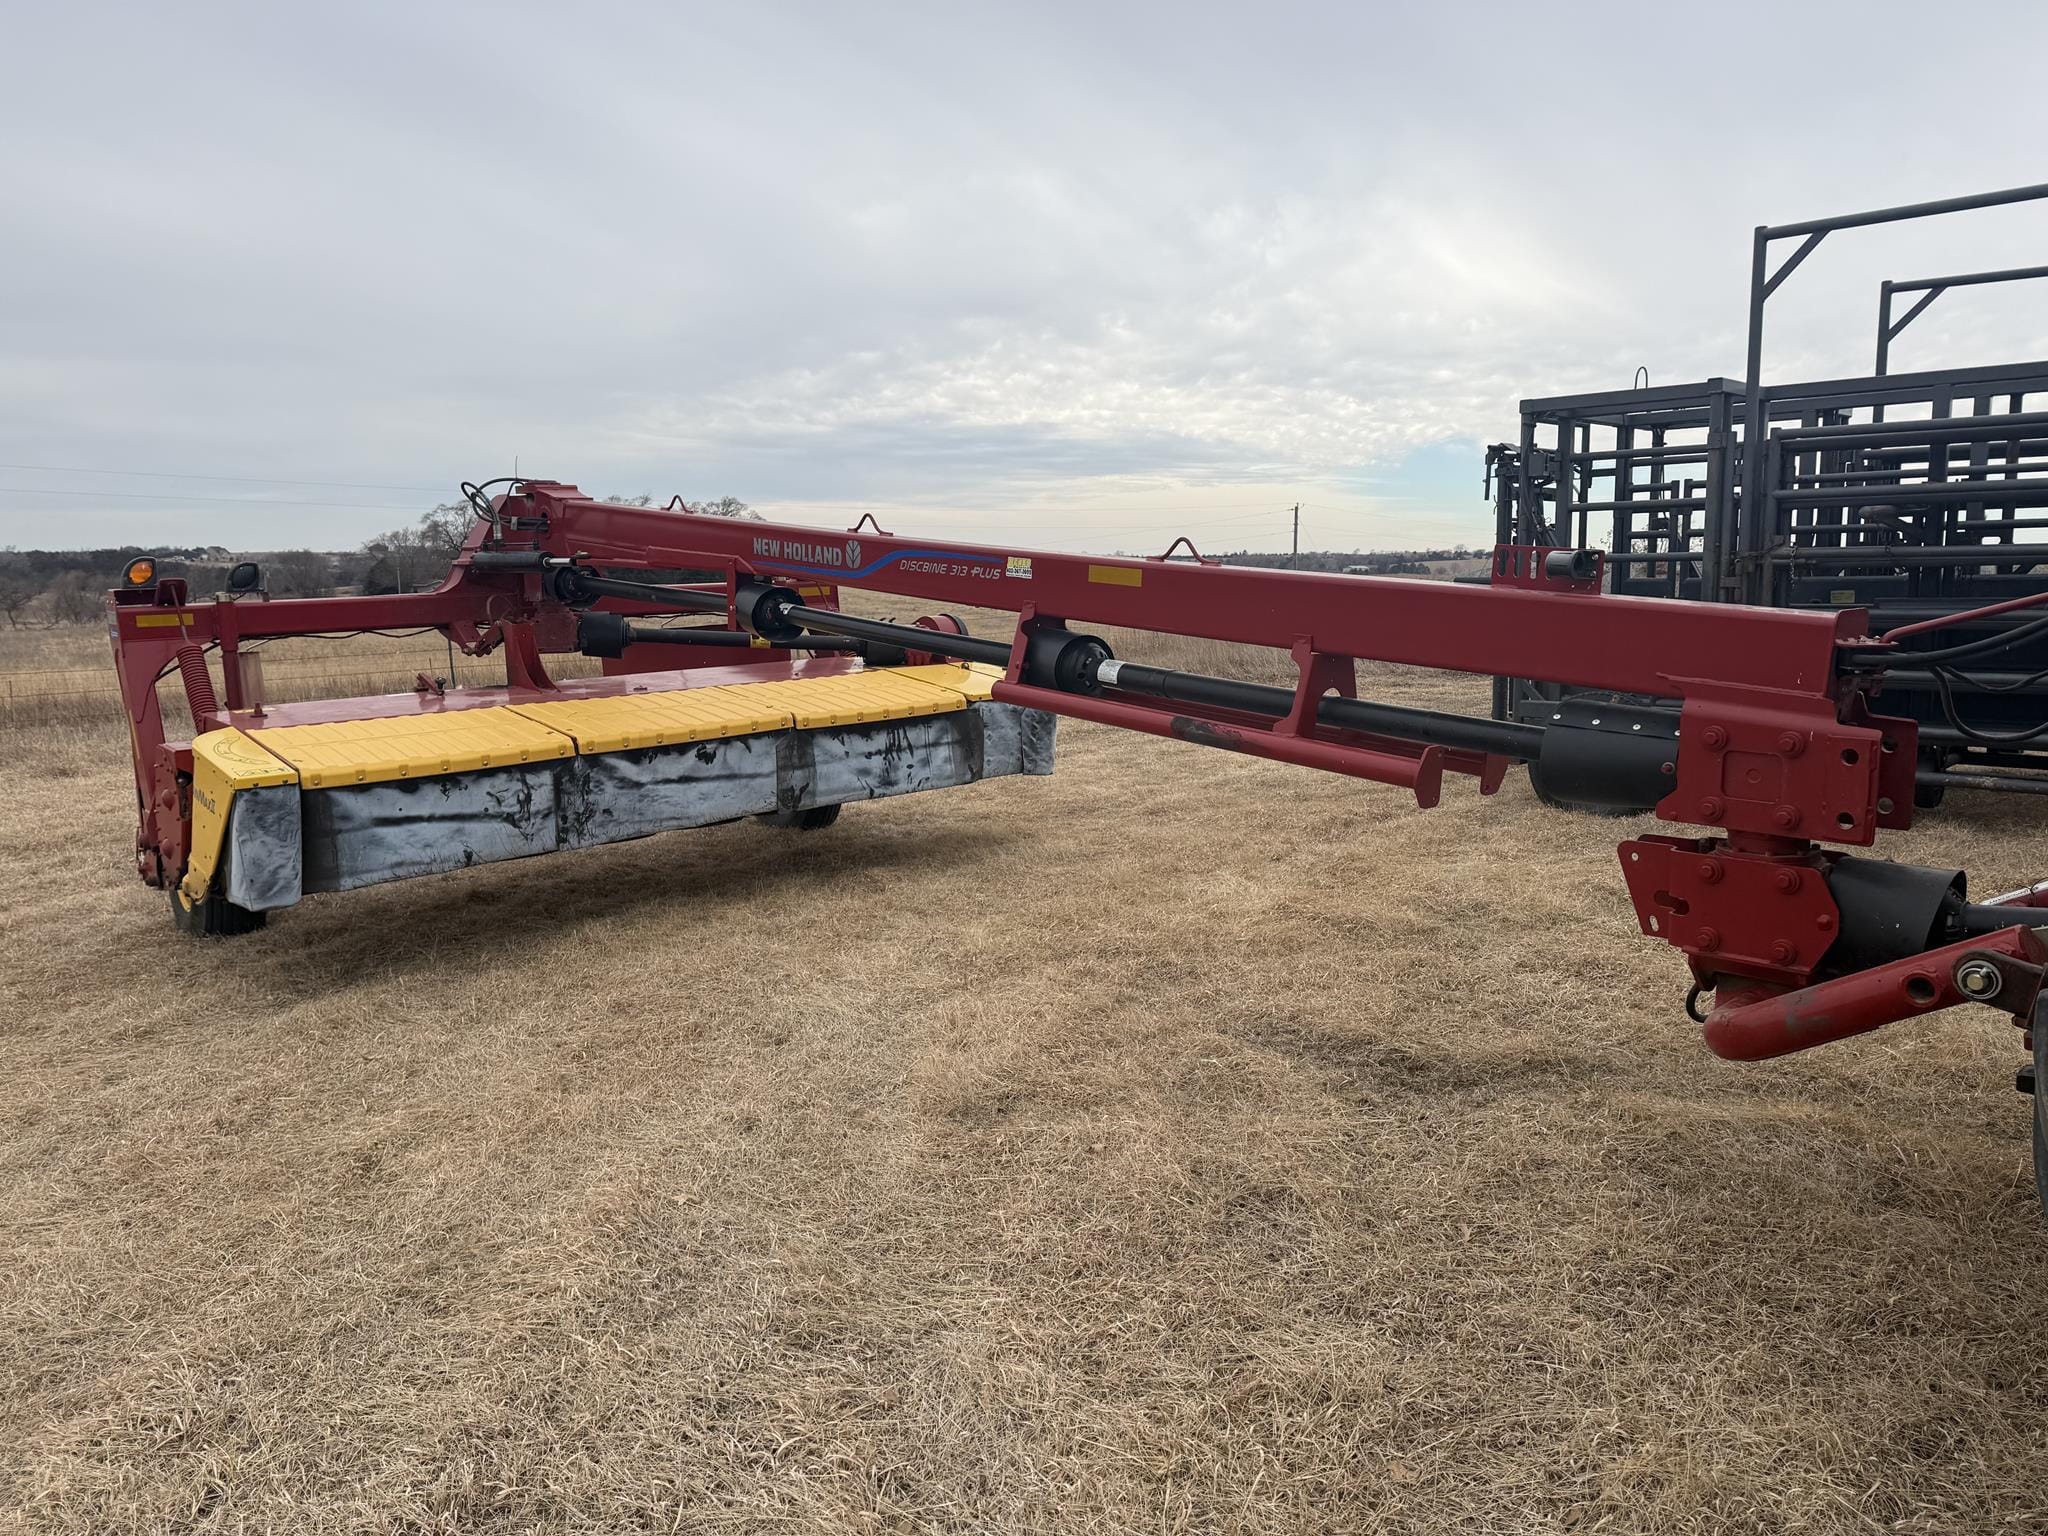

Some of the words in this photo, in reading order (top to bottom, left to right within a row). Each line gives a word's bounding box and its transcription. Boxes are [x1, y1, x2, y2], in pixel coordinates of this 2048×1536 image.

[753, 537, 780, 558] NEW
[783, 541, 842, 566] HOLLAND
[900, 560, 948, 575] DISCBINE
[950, 565, 968, 577] 313
